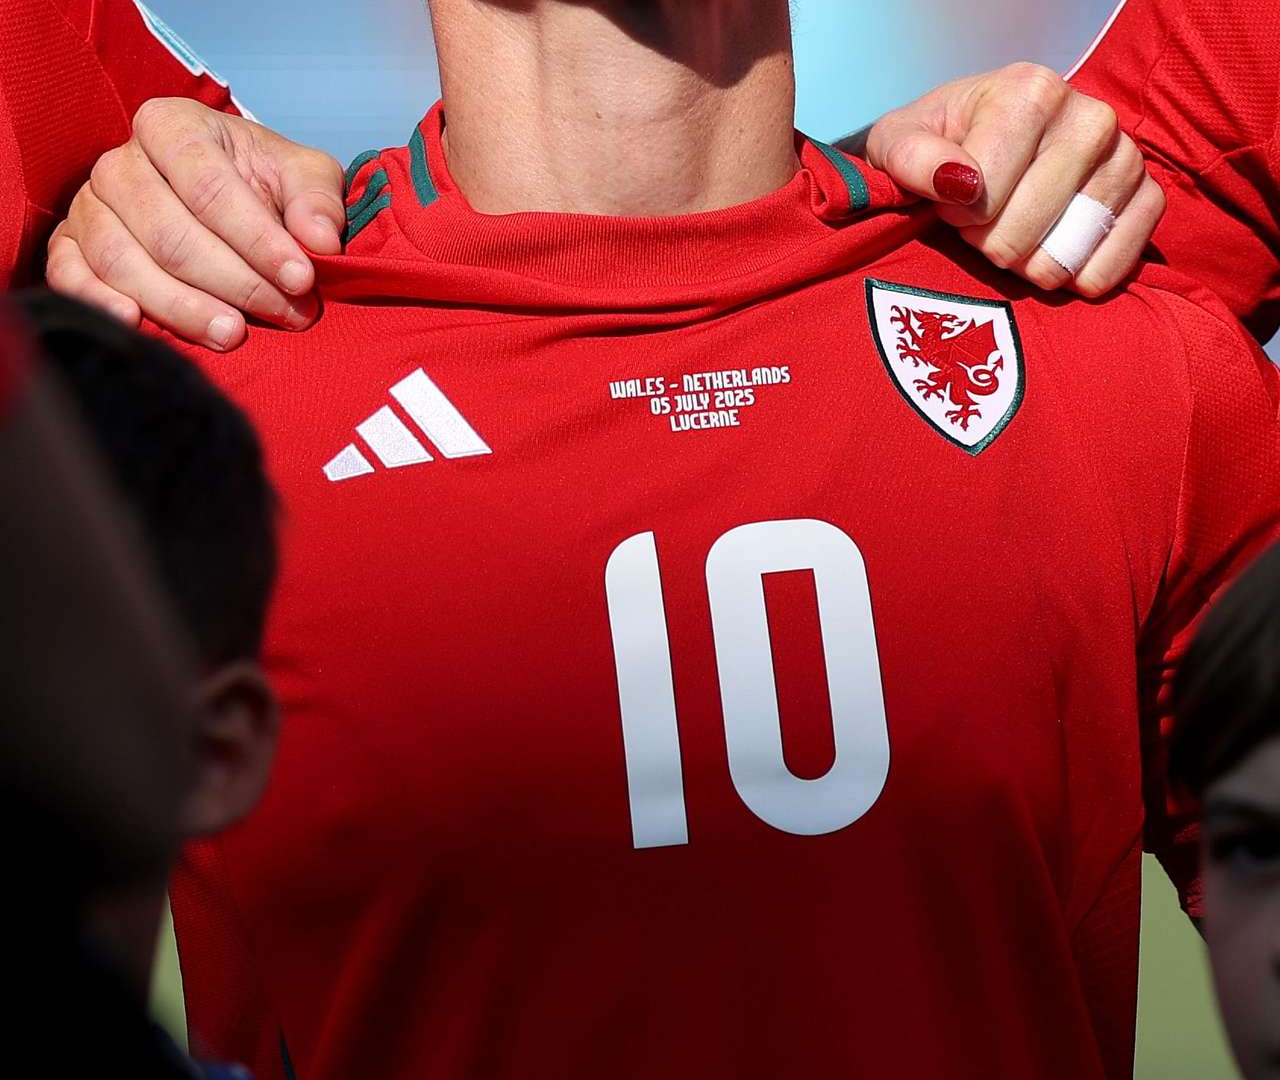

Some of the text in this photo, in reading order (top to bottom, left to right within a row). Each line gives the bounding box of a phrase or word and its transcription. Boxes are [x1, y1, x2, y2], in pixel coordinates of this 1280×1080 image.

[609, 376, 665, 399] WALES
[682, 366, 791, 393] NETHERLANDS
[650, 388, 755, 415] 05 JULY 2025
[669, 409, 741, 432] LUCERNE
[604, 518, 890, 850] 10
